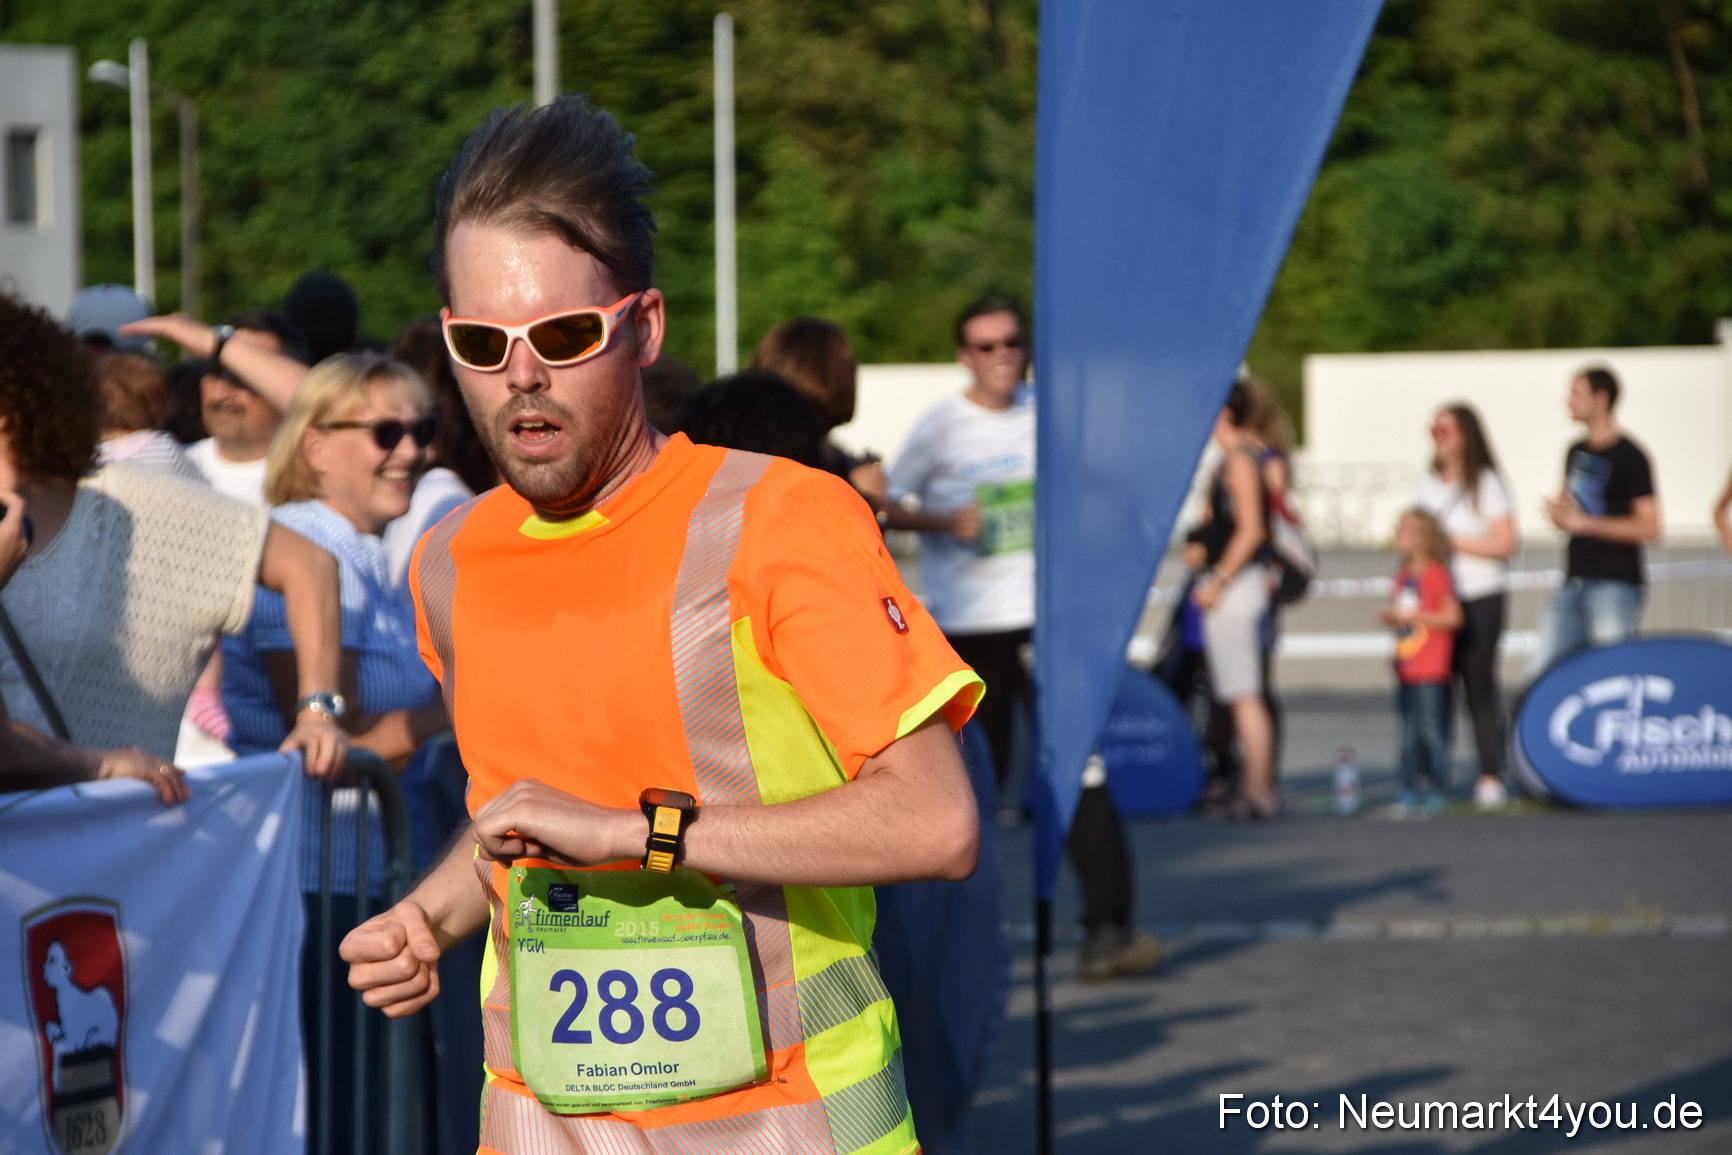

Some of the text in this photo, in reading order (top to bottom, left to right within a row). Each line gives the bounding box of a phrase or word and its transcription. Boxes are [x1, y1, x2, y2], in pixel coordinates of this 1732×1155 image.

[536, 909, 611, 928] firmenlauf
[535, 926, 567, 934] neumarkt
[614, 920, 660, 937] 2015
[549, 968, 701, 1045] 288
[577, 1061, 681, 1078] Fabian Omlor
[565, 1079, 697, 1093] DELTA BLOC Deutschland GmbH
[64, 1108, 107, 1152] 1628
